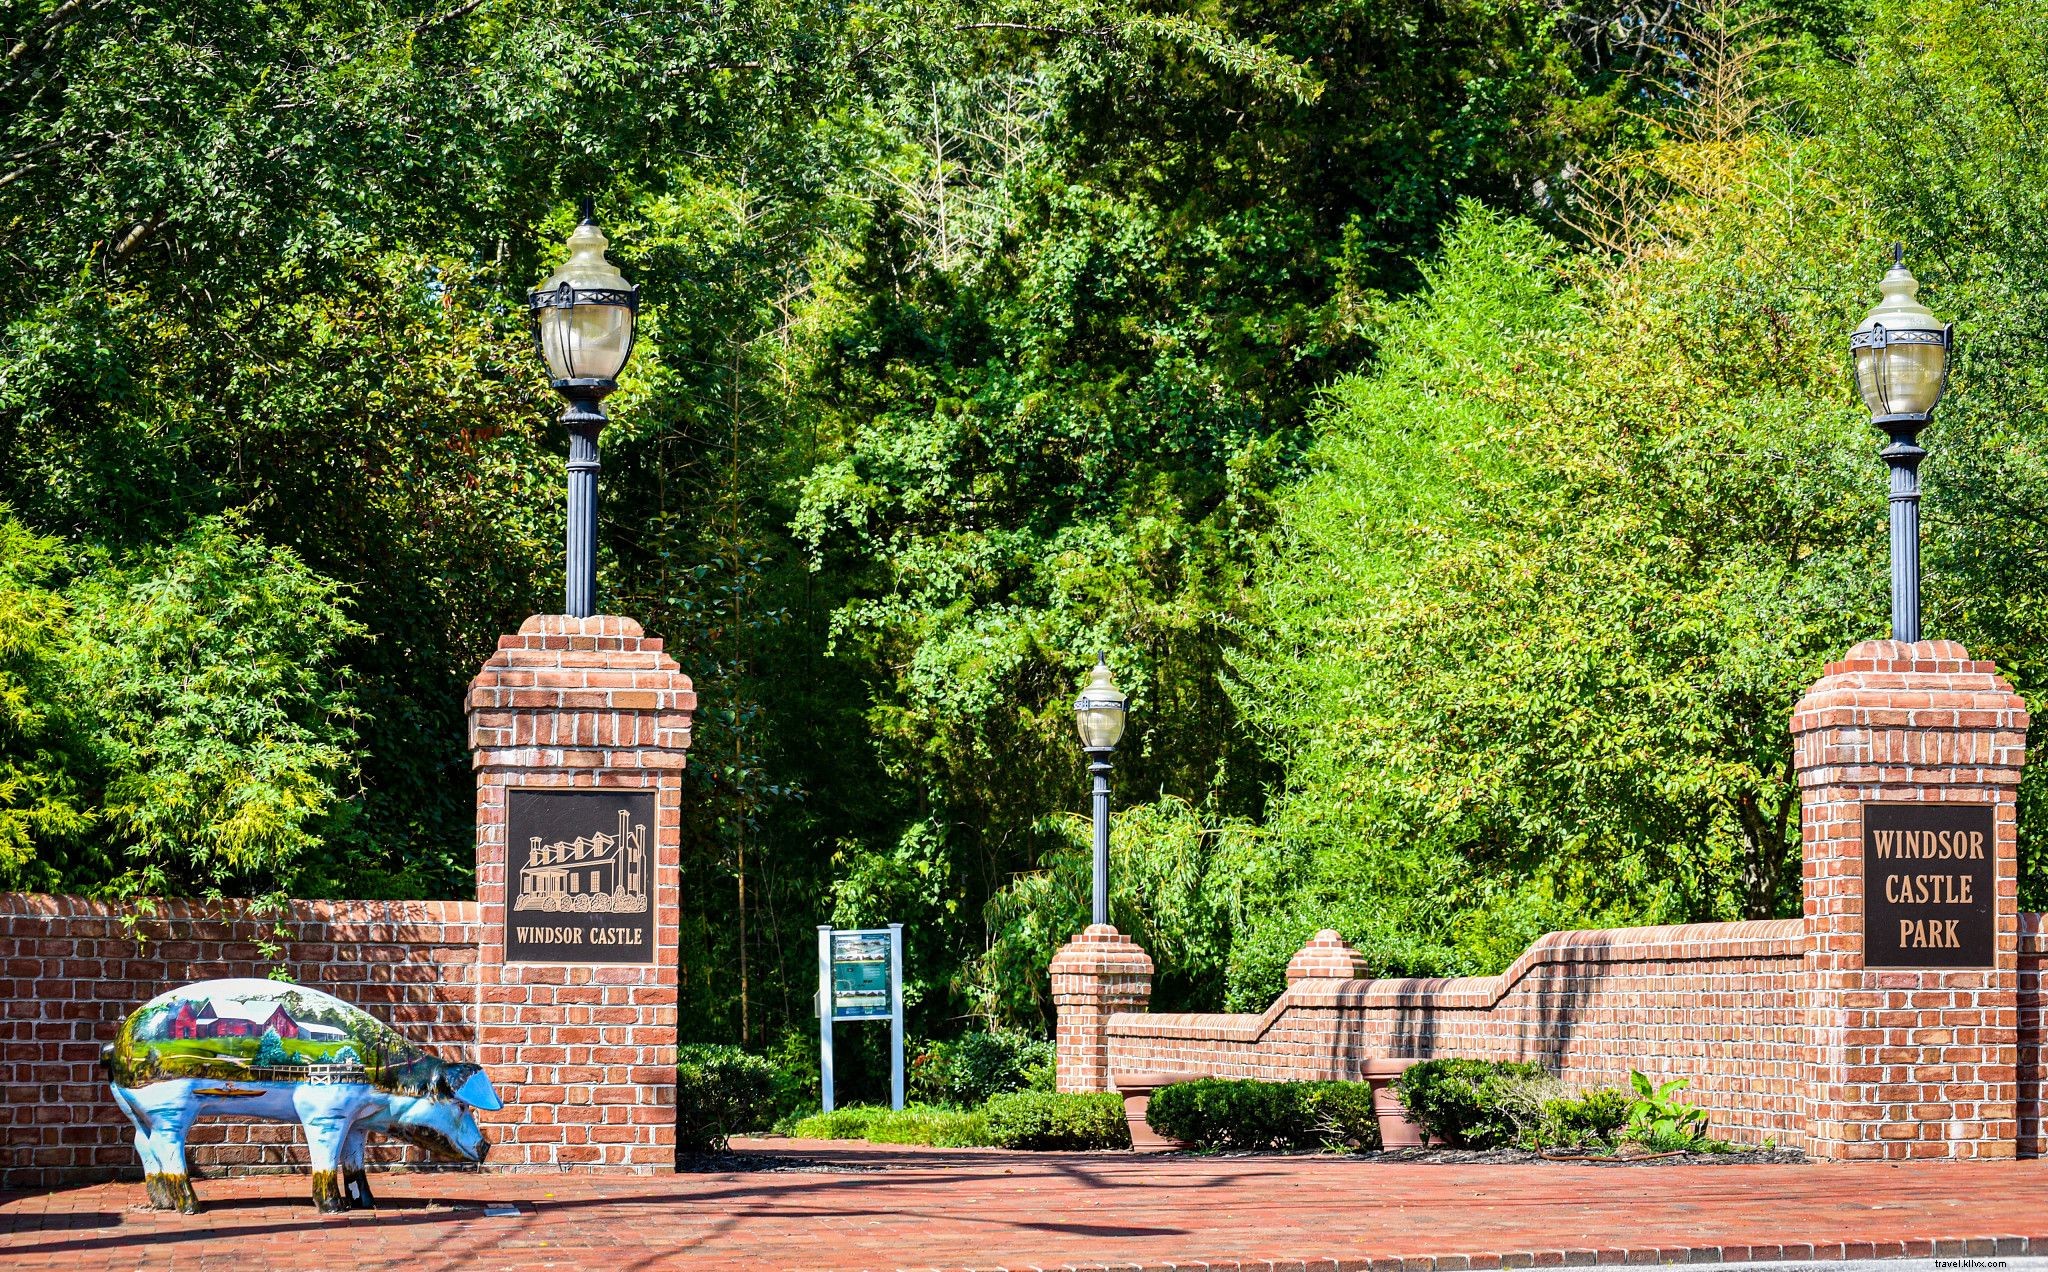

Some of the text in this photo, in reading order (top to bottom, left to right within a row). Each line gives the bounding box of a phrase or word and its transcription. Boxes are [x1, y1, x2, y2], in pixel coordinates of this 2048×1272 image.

[1873, 830, 1984, 859] WINDSOR
[1885, 874, 1972, 904] CASTLE
[516, 926, 642, 945] WINDSOR CASTLE
[1899, 919, 1961, 948] PARK
